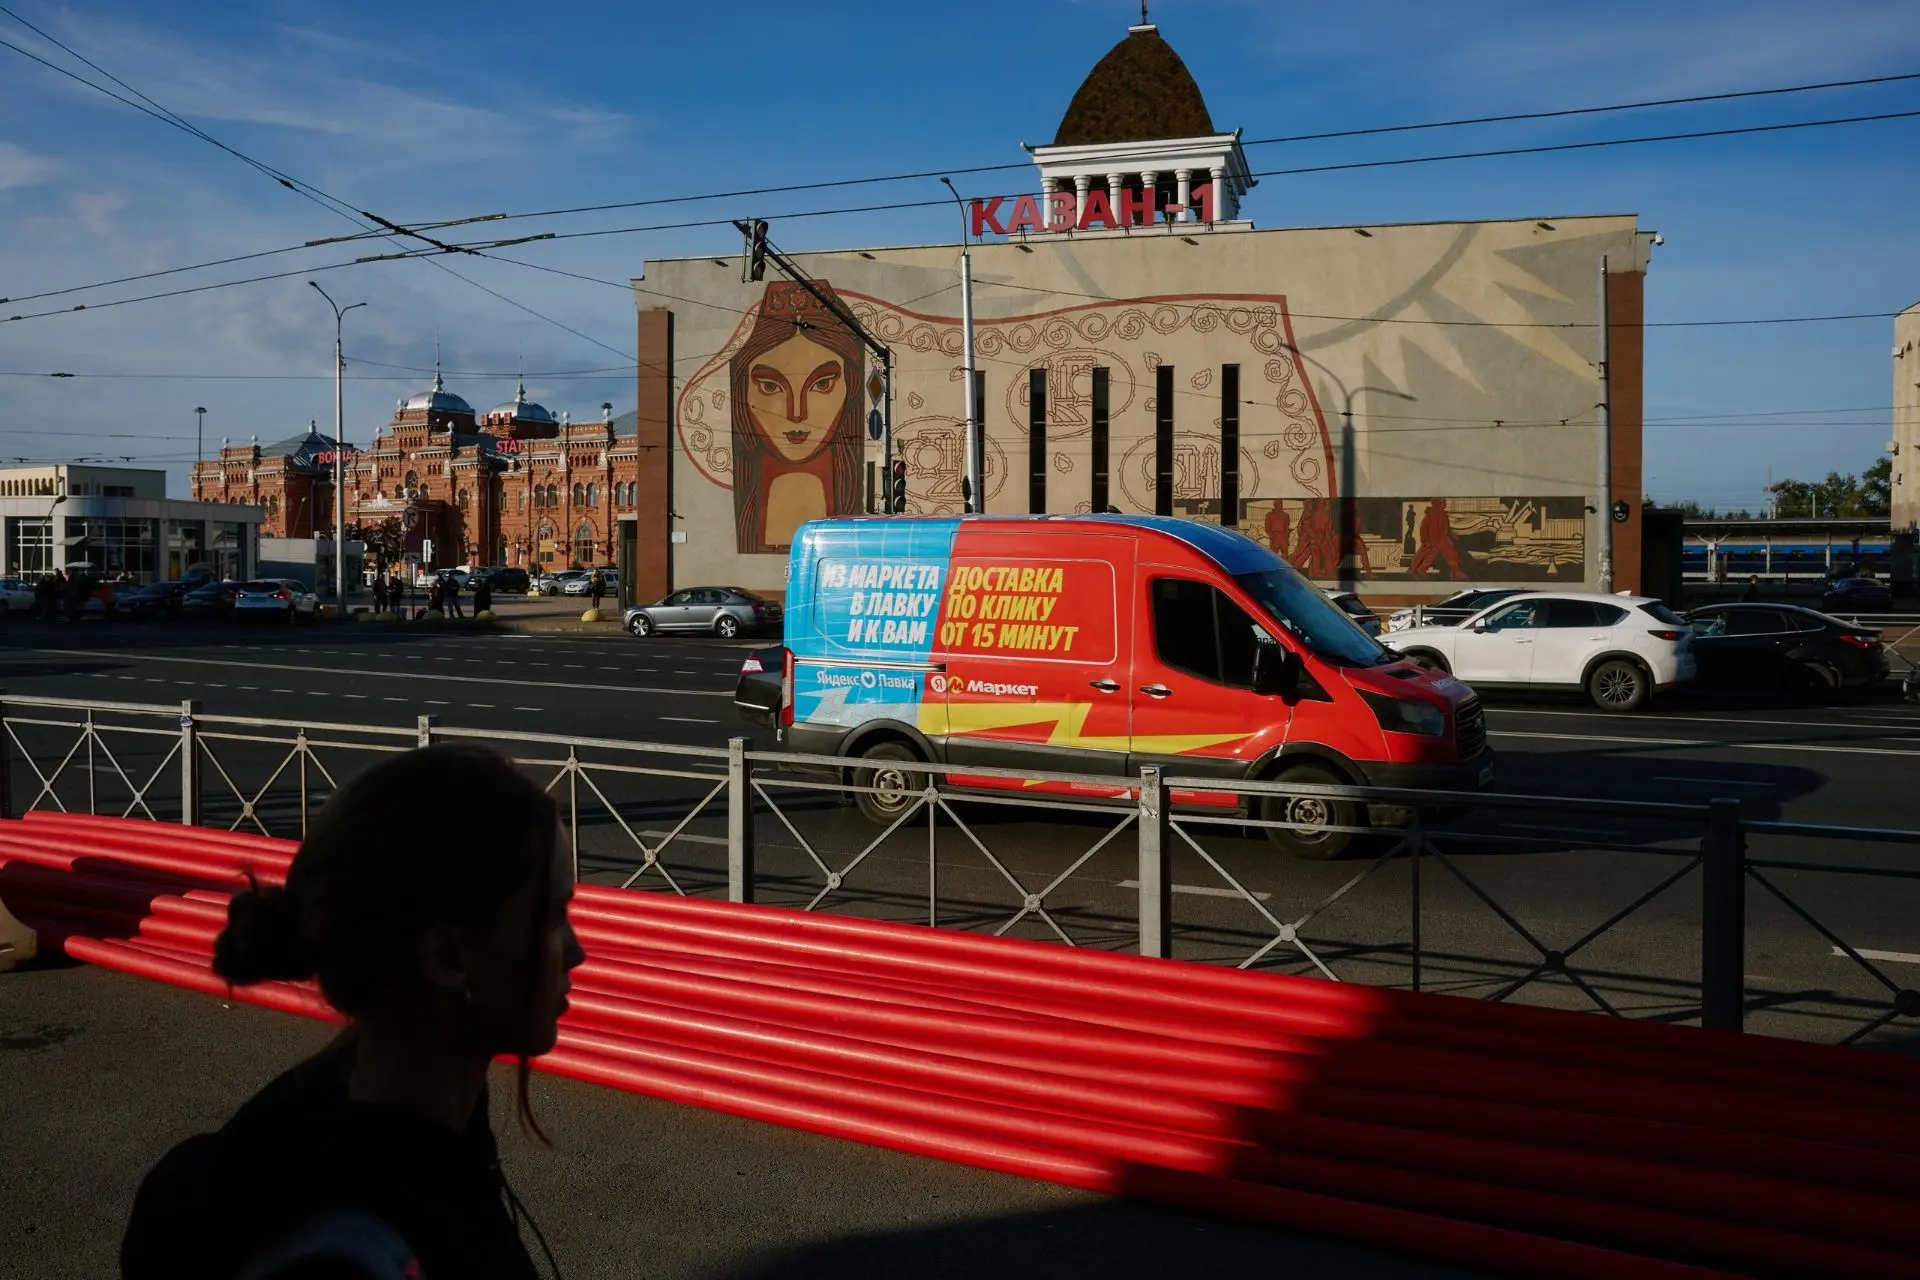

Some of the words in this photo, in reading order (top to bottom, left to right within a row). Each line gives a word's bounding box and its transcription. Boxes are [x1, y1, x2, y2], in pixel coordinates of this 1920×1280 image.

[971, 183, 1214, 235] КАЗАН-1
[822, 564, 846, 588] ИЗ
[848, 565, 940, 589] МАРКЕТА
[950, 566, 1064, 595] ДОСТАВКА
[850, 592, 864, 615] В
[866, 592, 936, 617] ЛАВКУ
[946, 594, 977, 619] ПО
[979, 595, 1058, 621] КЛИКУ
[847, 619, 863, 642] И
[865, 619, 880, 643] К
[882, 620, 927, 644] ВАМ
[940, 622, 969, 647] ОТ
[971, 622, 996, 648] 15
[997, 623, 1079, 651] МИНУТ
[816, 671, 861, 686] Яндекс
[878, 673, 915, 689] Лавка
[966, 680, 1039, 696] Маркет
